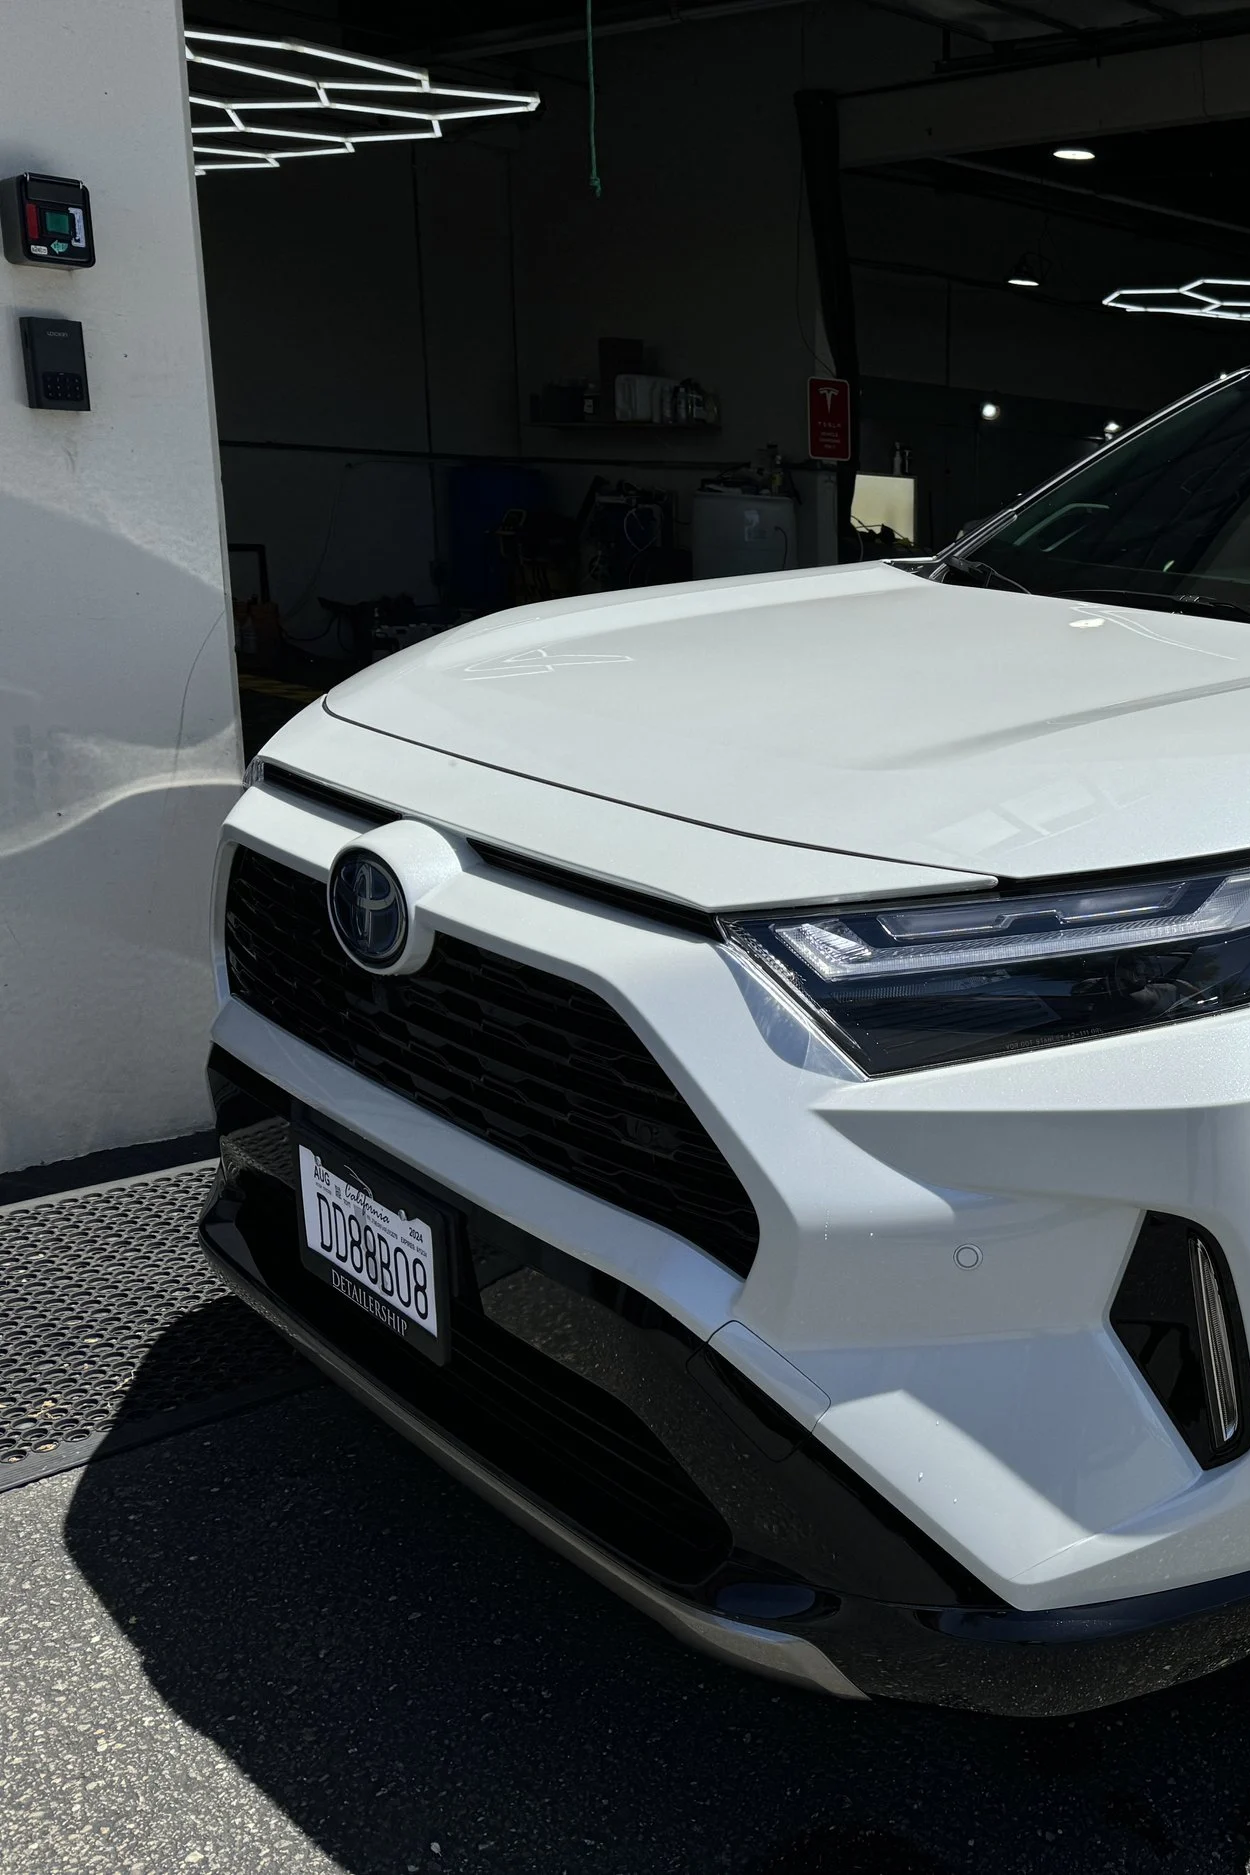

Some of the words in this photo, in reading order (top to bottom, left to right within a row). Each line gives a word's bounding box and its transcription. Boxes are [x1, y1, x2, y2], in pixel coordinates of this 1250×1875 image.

[313, 1164, 331, 1187] AUG
[345, 1182, 390, 1224] California
[316, 1190, 429, 1321] DD88B08
[408, 1225, 424, 1244] 2024
[331, 1268, 409, 1337] DETAILERSHIP
